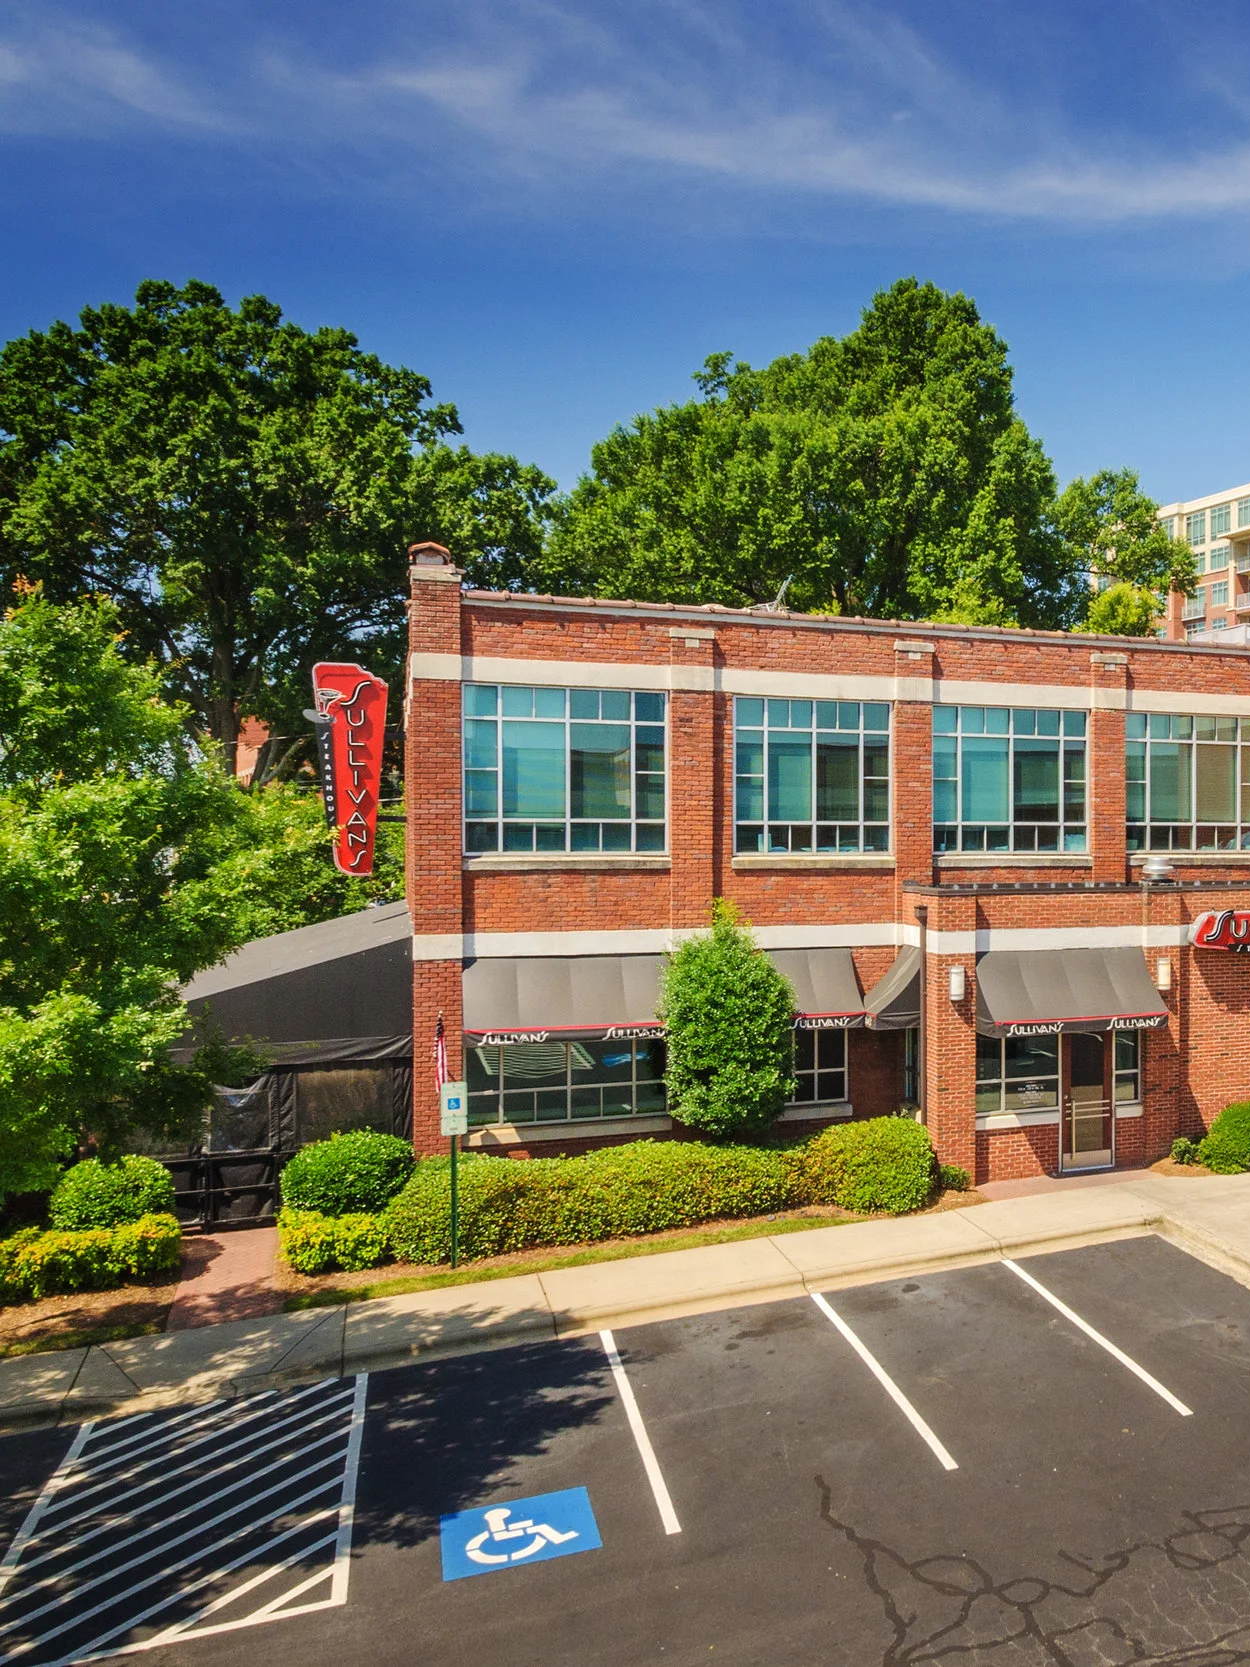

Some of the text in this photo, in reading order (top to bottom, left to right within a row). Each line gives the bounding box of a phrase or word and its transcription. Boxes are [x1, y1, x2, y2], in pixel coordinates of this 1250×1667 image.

[320, 731, 336, 823] STEAKHOUS
[790, 1016, 850, 1030] SULLIVAN'S
[1006, 1021, 1065, 1037] SULLIVAN'S
[1106, 1016, 1161, 1031] SULLIVAN'S
[477, 1031, 550, 1047] SULLIVAN'S
